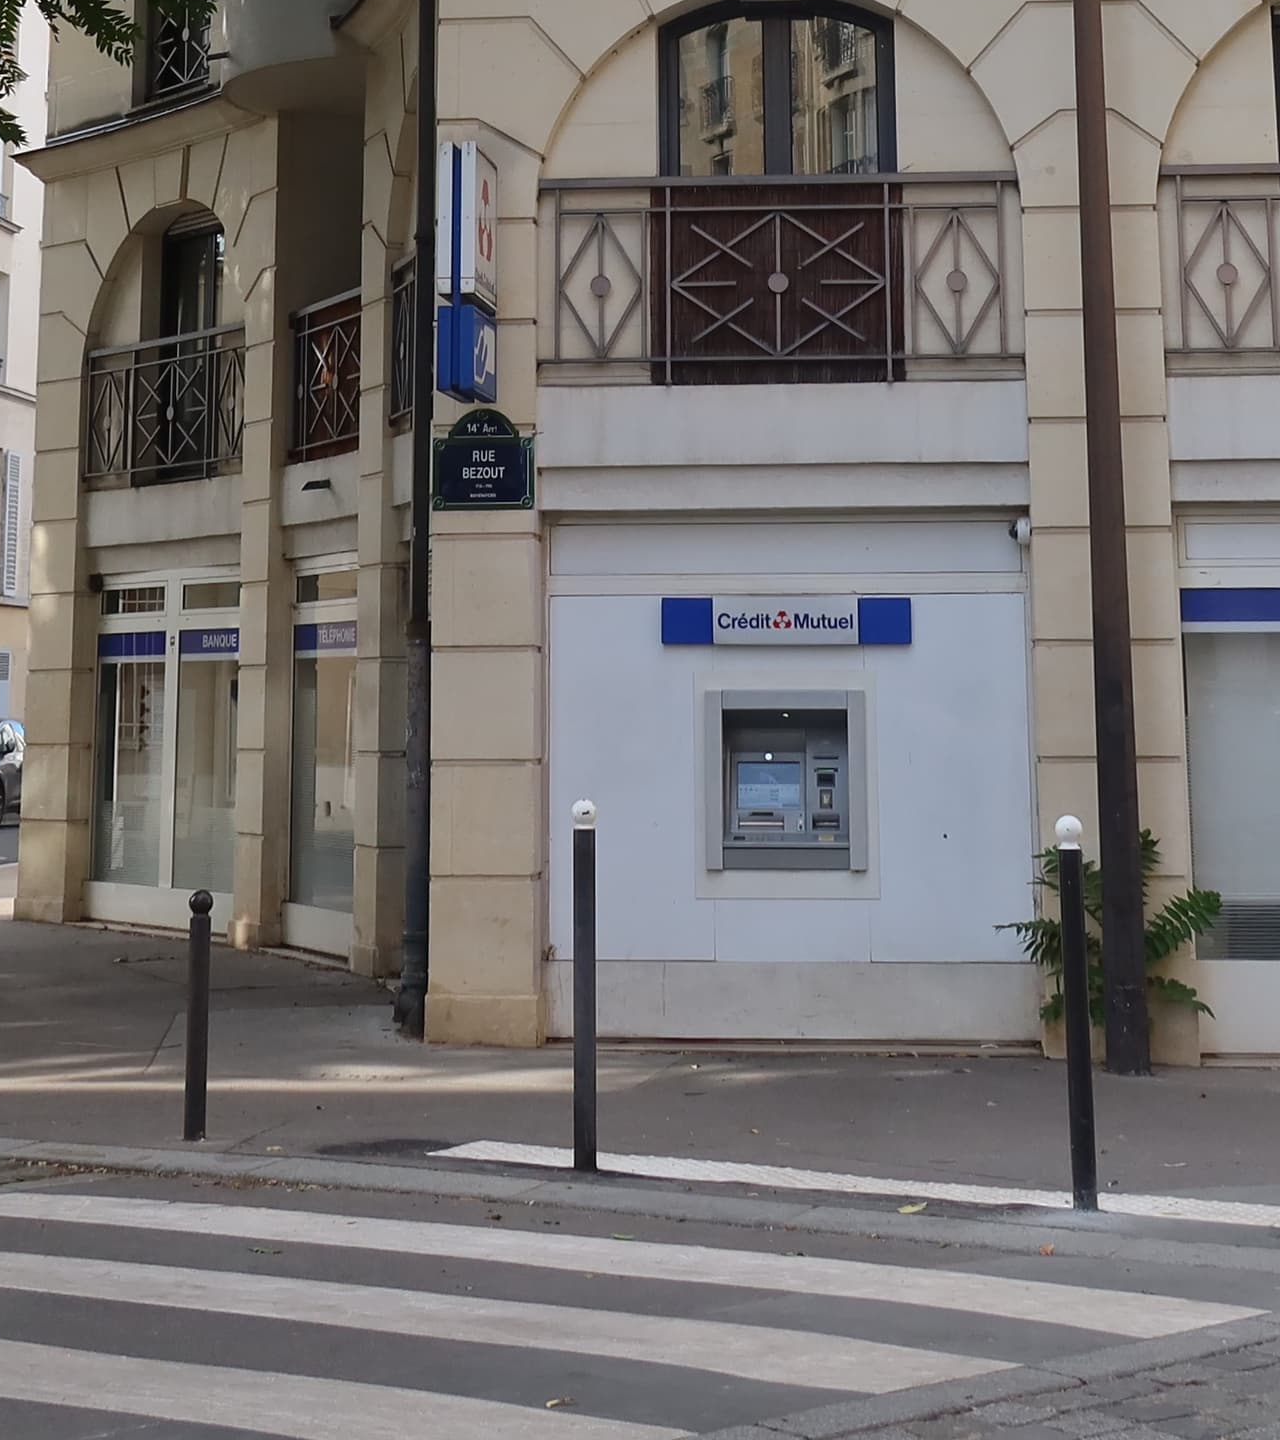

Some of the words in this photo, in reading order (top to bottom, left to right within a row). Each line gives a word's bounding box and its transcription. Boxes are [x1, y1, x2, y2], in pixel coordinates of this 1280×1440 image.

[472, 450, 496, 462] RUE
[462, 467, 505, 479] BEZOUT
[717, 612, 771, 629] Crédit
[794, 613, 853, 629] Mutuel
[202, 633, 237, 648] BANQUE
